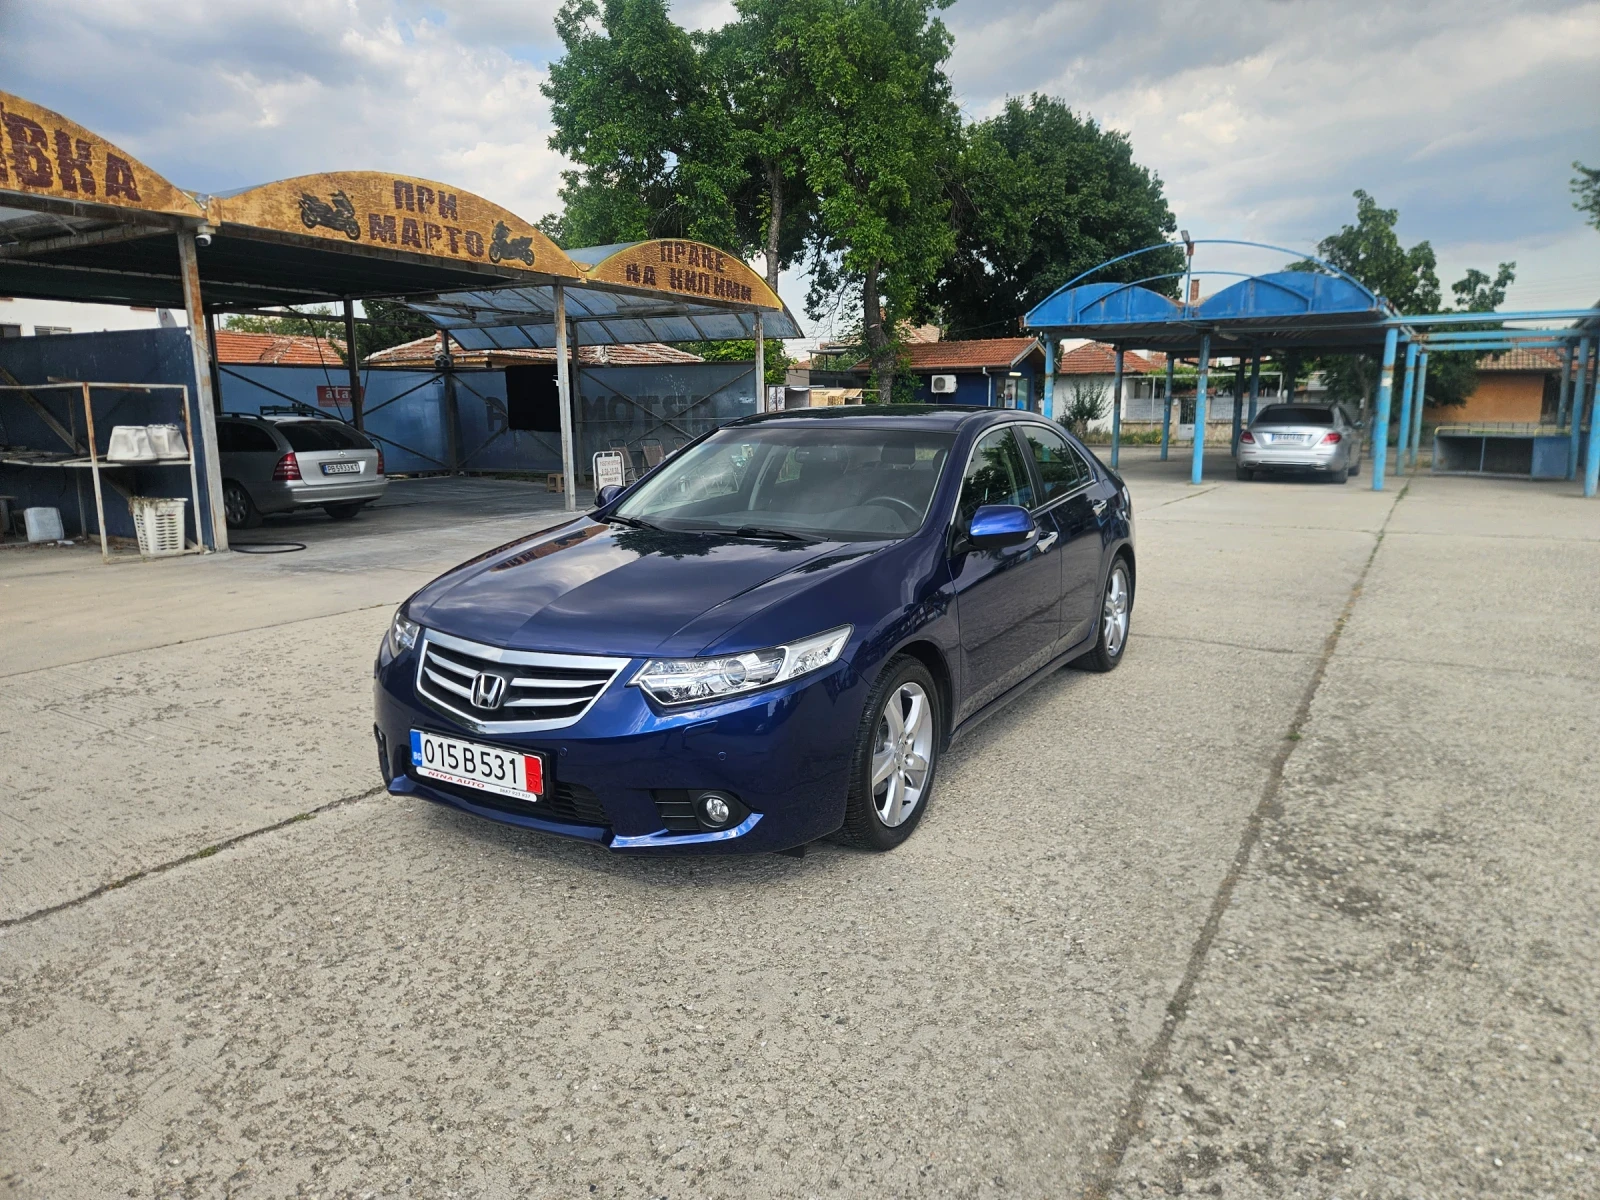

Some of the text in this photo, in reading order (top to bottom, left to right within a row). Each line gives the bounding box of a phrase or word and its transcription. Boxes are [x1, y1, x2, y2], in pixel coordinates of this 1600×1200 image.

[393, 180, 458, 221] ПРИ
[368, 213, 485, 258] МАРТО
[660, 241, 725, 273] ПРАНЕ
[626, 263, 656, 286] НА
[413, 751, 422, 761] BG
[428, 771, 485, 789] NINA AUTO
